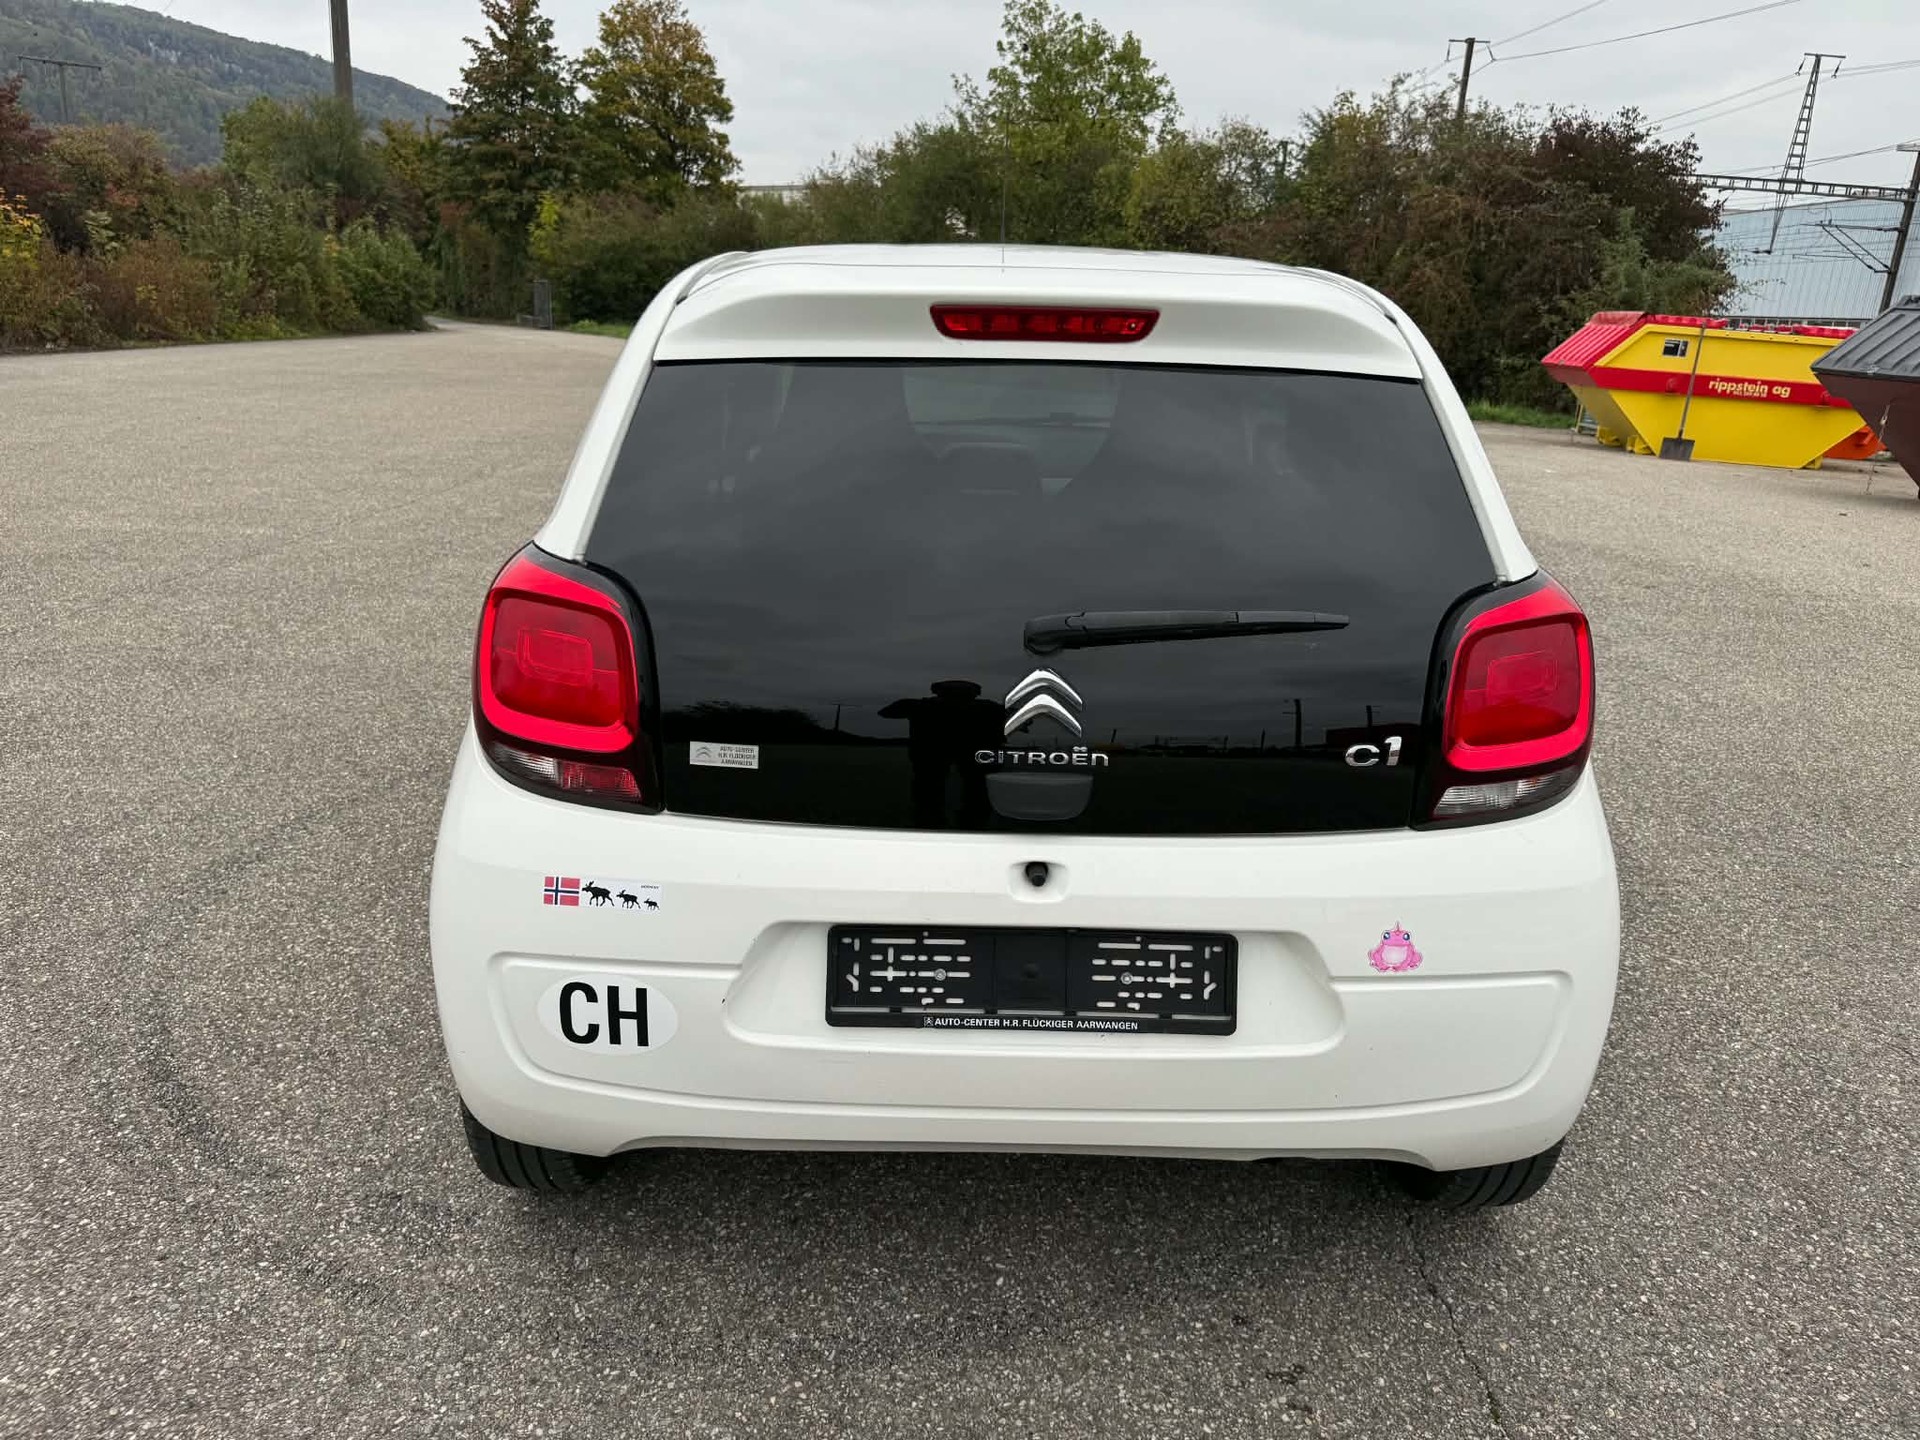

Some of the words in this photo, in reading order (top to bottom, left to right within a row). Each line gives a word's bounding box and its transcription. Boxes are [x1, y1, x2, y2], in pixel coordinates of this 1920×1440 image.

[1708, 377, 1769, 395] rippstein
[1772, 385, 1791, 398] ag
[1345, 736, 1402, 767] C1
[559, 981, 649, 1047] CH
[934, 1017, 1000, 1027] AUTO-CENTER
[1003, 1019, 1021, 1027] H.R.
[1022, 1018, 1074, 1028] FLÜCKIGER
[1076, 1020, 1138, 1030] AARWANGEN
